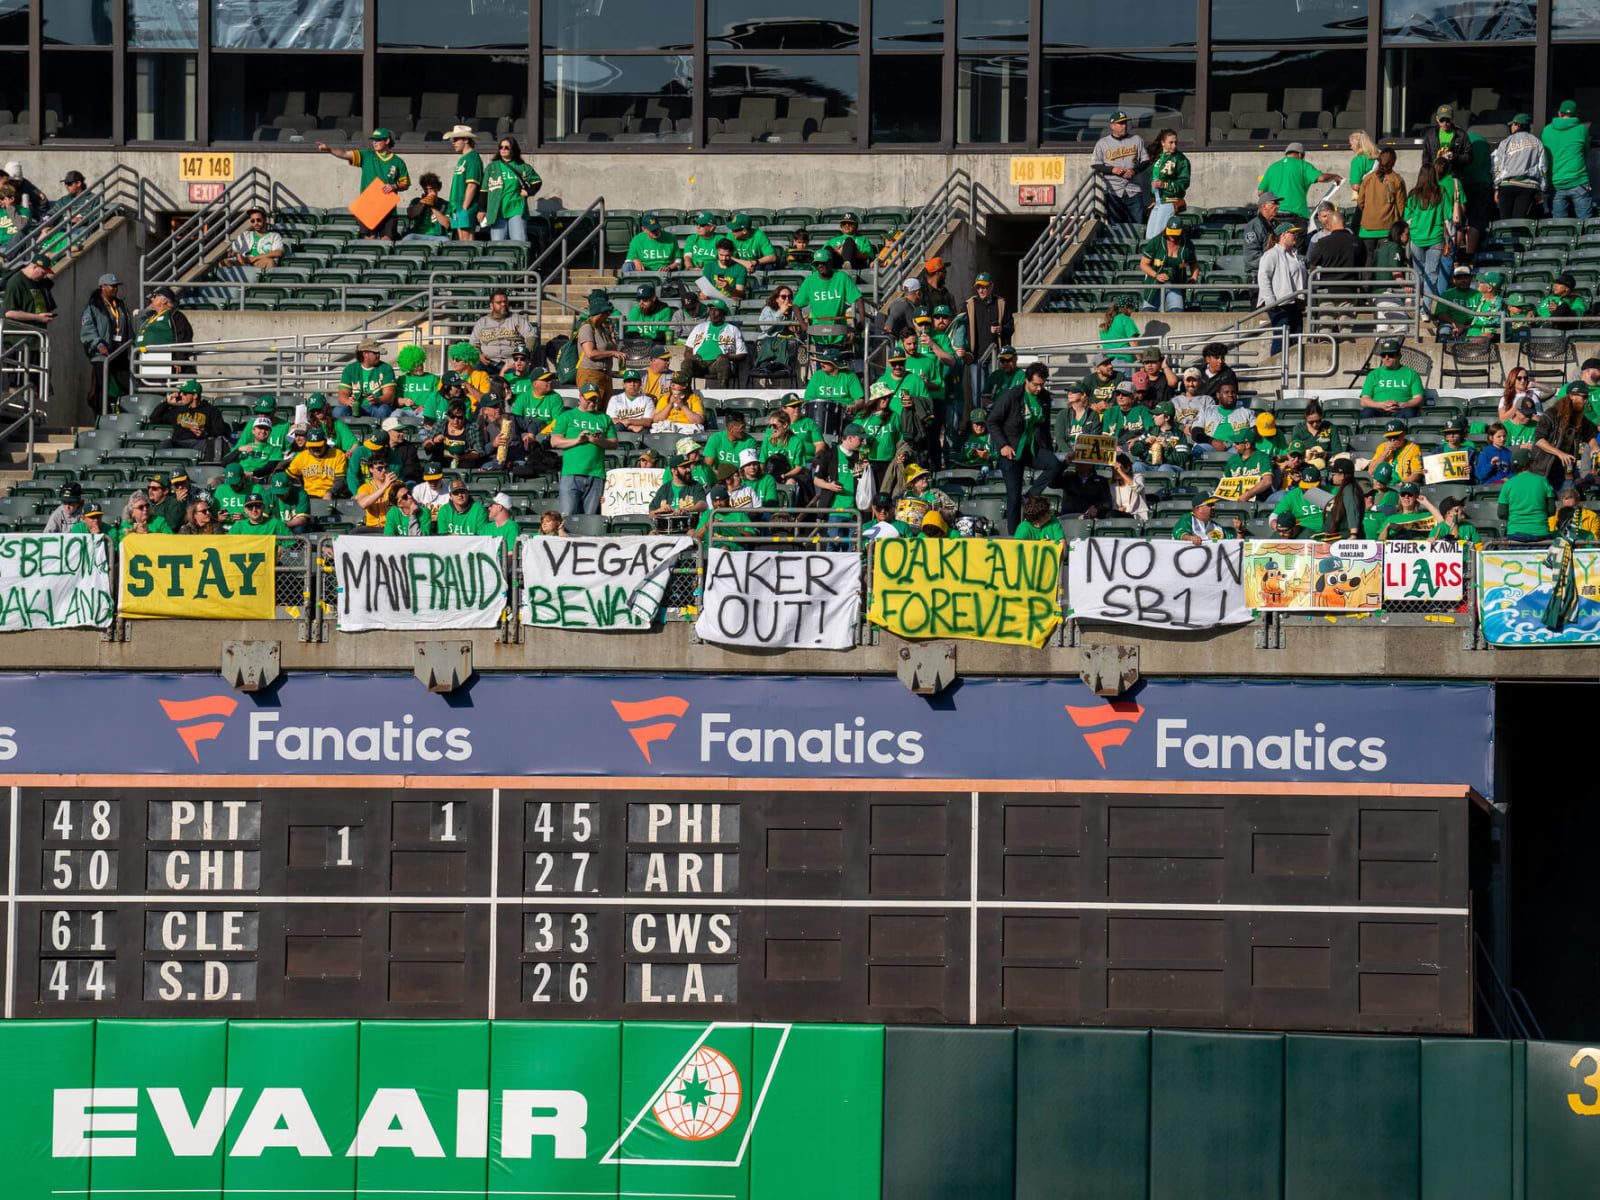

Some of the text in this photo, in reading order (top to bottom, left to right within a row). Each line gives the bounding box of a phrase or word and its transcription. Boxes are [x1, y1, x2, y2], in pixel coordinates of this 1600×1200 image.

[183, 157, 231, 177] 147 148
[1014, 160, 1062, 180] 148 149
[193, 184, 220, 201] EXIT
[1023, 187, 1051, 203] EXIT
[643, 249, 670, 259] SELL
[692, 245, 717, 257] SELL
[813, 290, 841, 302] SELL
[402, 384, 430, 393] SELL
[818, 385, 847, 396] SELL
[1378, 378, 1408, 388] SELL
[525, 406, 551, 418] SELL
[573, 419, 602, 431] SELL
[718, 450, 740, 464] SEL
[1452, 455, 1466, 463] THE
[222, 496, 243, 507] SEL
[448, 524, 474, 535] SELL
[127, 547, 266, 600] STAY
[543, 540, 675, 577] VEGAS
[708, 551, 838, 596] AKER
[880, 537, 1058, 594] OAKLAND
[1086, 538, 1244, 585] NO ON
[1386, 558, 1462, 598] LIARS
[1500, 556, 1598, 588] STY
[528, 584, 642, 627] BEWA
[717, 595, 826, 643] OUT!
[881, 588, 1058, 640] FOREVER
[249, 711, 473, 761] Fanatics
[700, 713, 925, 764] Fanatics
[1156, 718, 1388, 771] Fanatics
[170, 801, 247, 840] PIT
[441, 802, 457, 841] 1
[648, 804, 721, 843] PHI
[337, 826, 353, 866] 1
[165, 850, 244, 890] CHI
[644, 853, 724, 892] ARI
[162, 911, 244, 951] CLE
[631, 914, 732, 954] CWS
[158, 961, 242, 1001] S.D.
[641, 963, 723, 1004] L.A.
